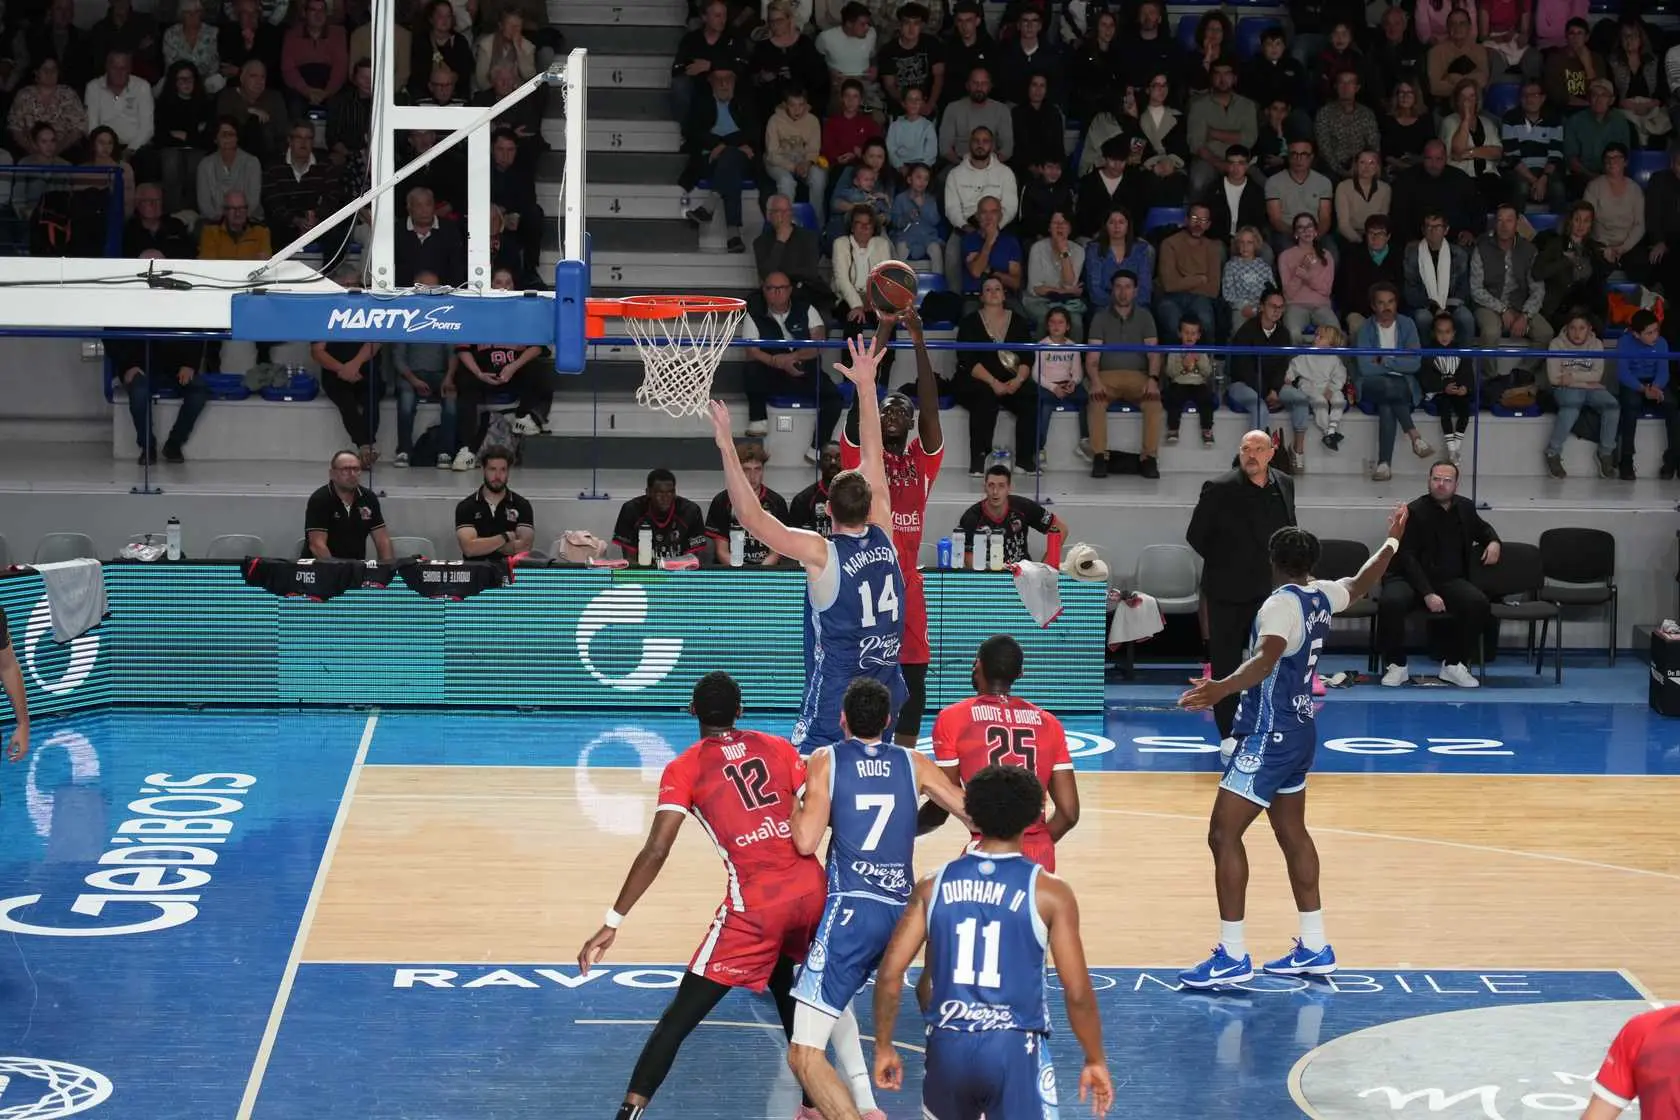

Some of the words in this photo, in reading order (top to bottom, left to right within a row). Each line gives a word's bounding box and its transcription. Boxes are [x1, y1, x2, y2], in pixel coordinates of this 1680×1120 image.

[610, 199, 621, 213] 4
[327, 308, 421, 330] MARTY
[858, 573, 899, 628] 14
[971, 704, 1004, 722] MOUTE
[1004, 708, 1012, 723] A
[721, 742, 747, 761] DIOP
[985, 724, 1038, 777] 25
[856, 760, 892, 778] ROOS
[722, 756, 781, 812] 12
[855, 794, 896, 851] 7
[942, 879, 1007, 906] DURHAM
[840, 908, 855, 926] 7
[953, 917, 1001, 988] 11
[393, 968, 690, 989] RAVO
